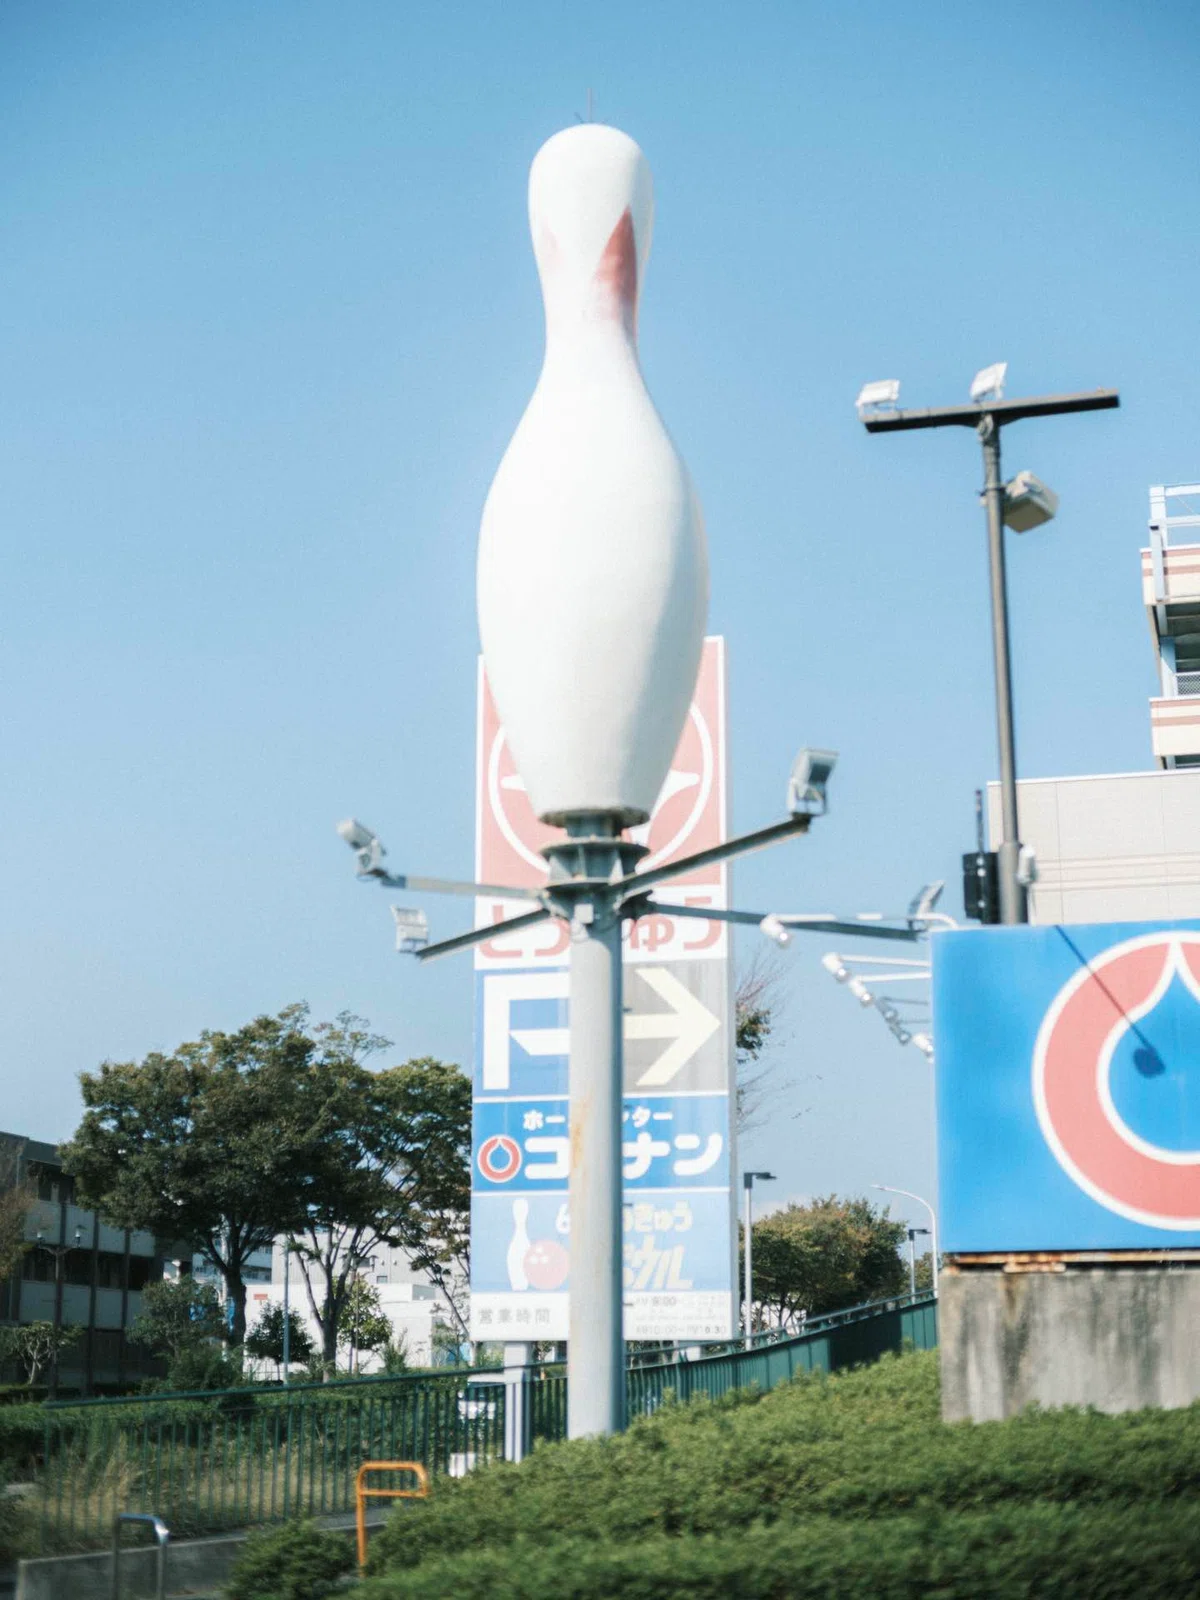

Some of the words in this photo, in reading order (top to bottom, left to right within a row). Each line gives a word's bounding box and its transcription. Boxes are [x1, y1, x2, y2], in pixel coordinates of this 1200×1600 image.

[525, 1132, 723, 1180] コナン
[478, 1307, 551, 1325] 営業時間
